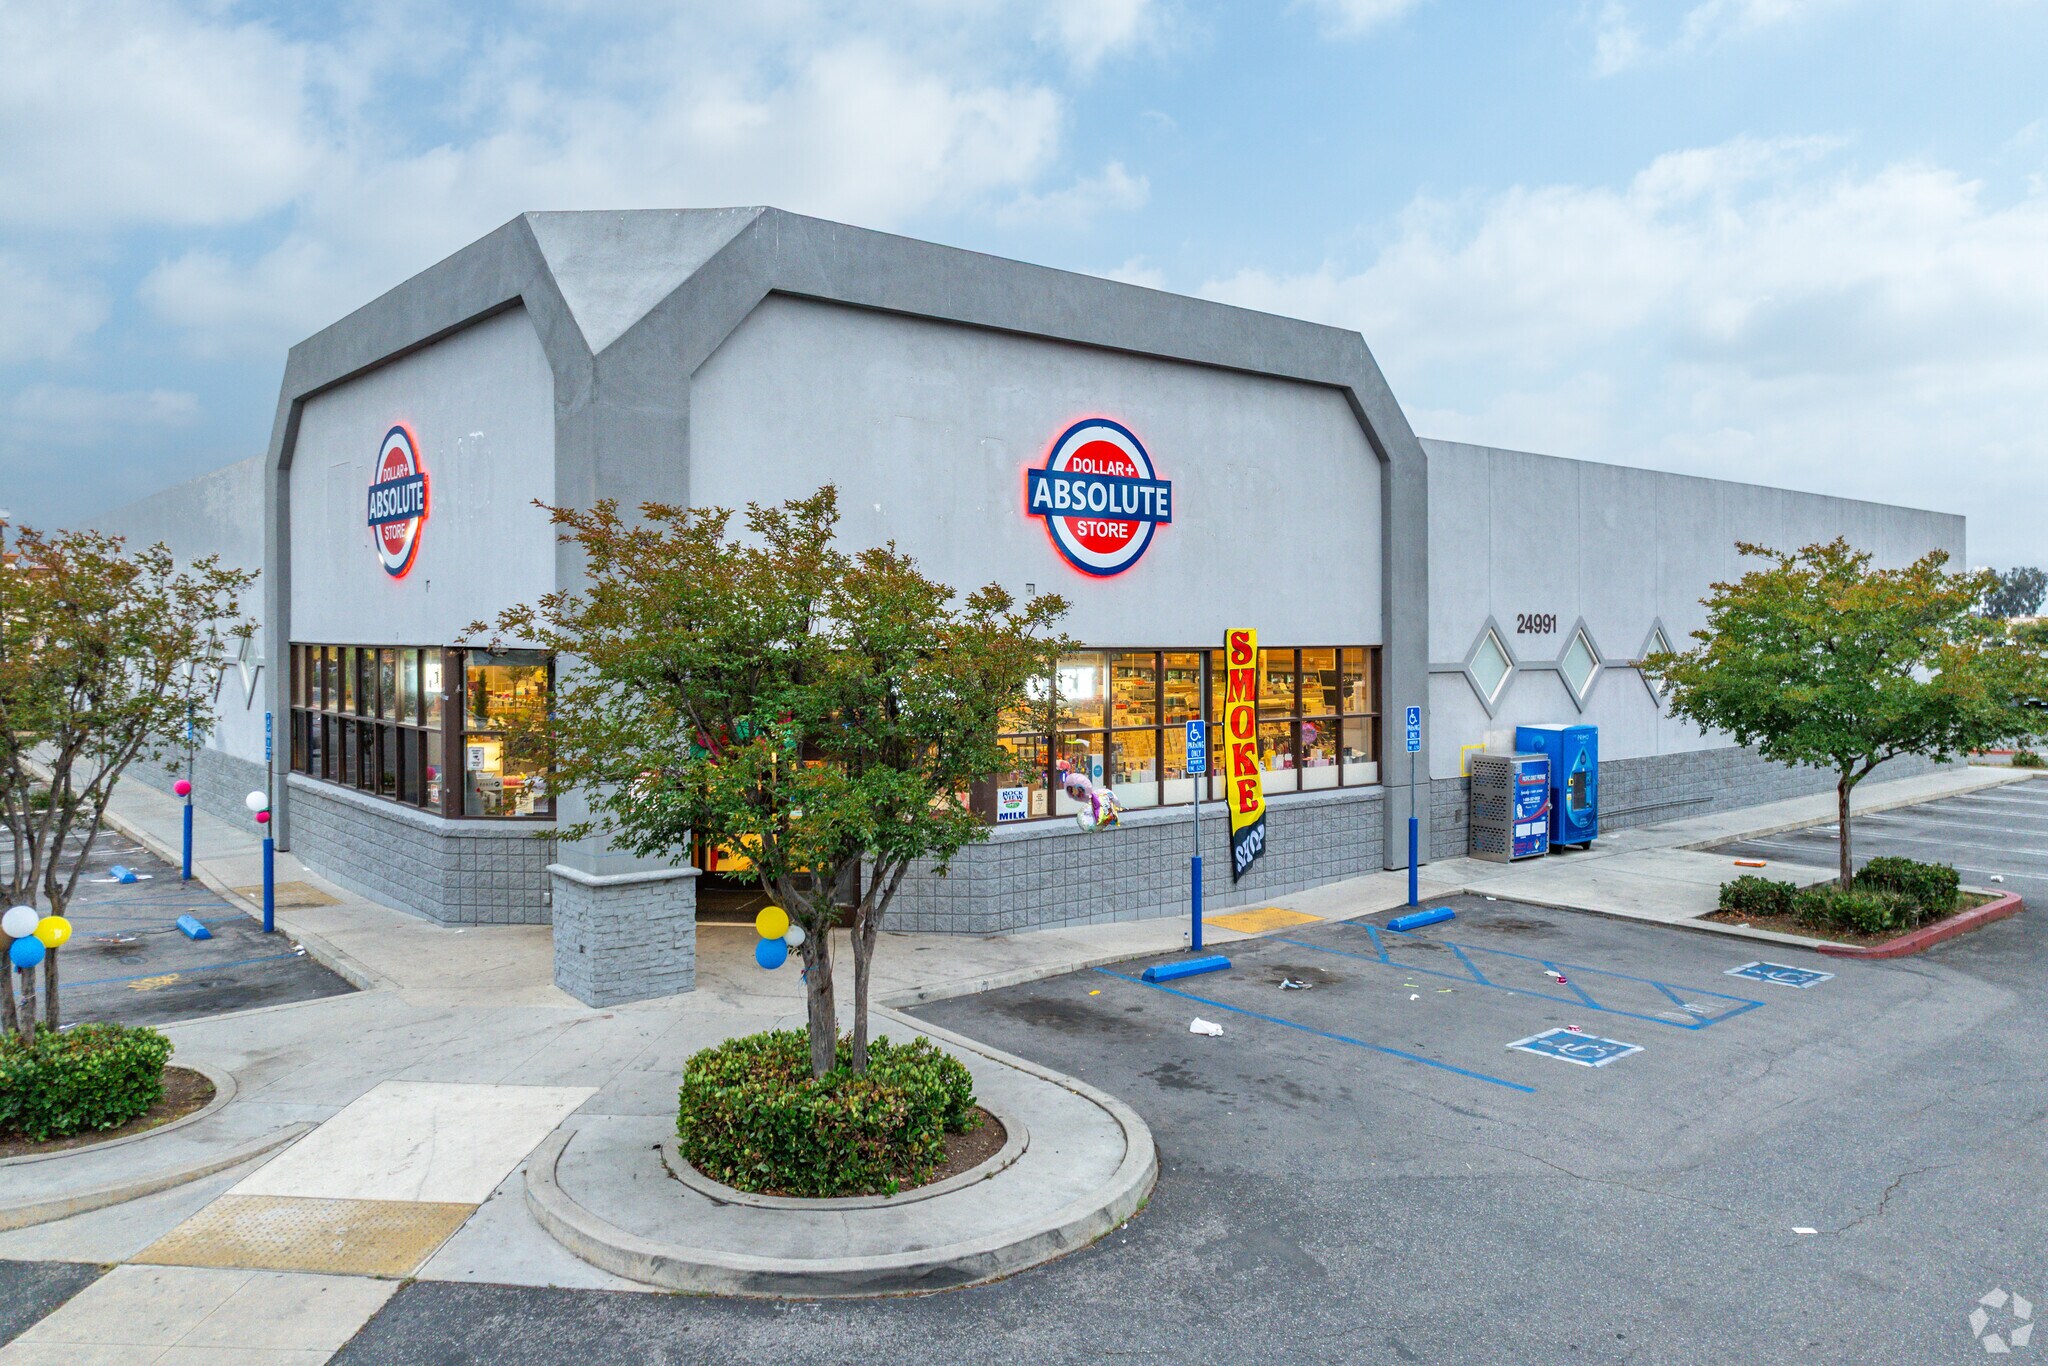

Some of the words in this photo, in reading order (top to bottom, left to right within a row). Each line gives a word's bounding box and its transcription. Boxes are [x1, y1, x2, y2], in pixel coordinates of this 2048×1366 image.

[383, 463, 408, 482] DOLLAR+
[1073, 457, 1134, 476] DOLLAR+
[369, 480, 424, 520] ABSOLUTE
[1033, 477, 1168, 516] ABSOLUTE
[384, 523, 406, 540] STORE
[1077, 520, 1129, 539] STORE
[1516, 613, 1556, 634] 24991
[1228, 631, 1258, 814] SMOKE
[1188, 741, 1204, 749] PARKING
[1191, 749, 1202, 758] ONLY
[1002, 790, 1024, 798] ROCK
[998, 811, 1026, 821] MILK
[1235, 823, 1265, 873] SHOP
